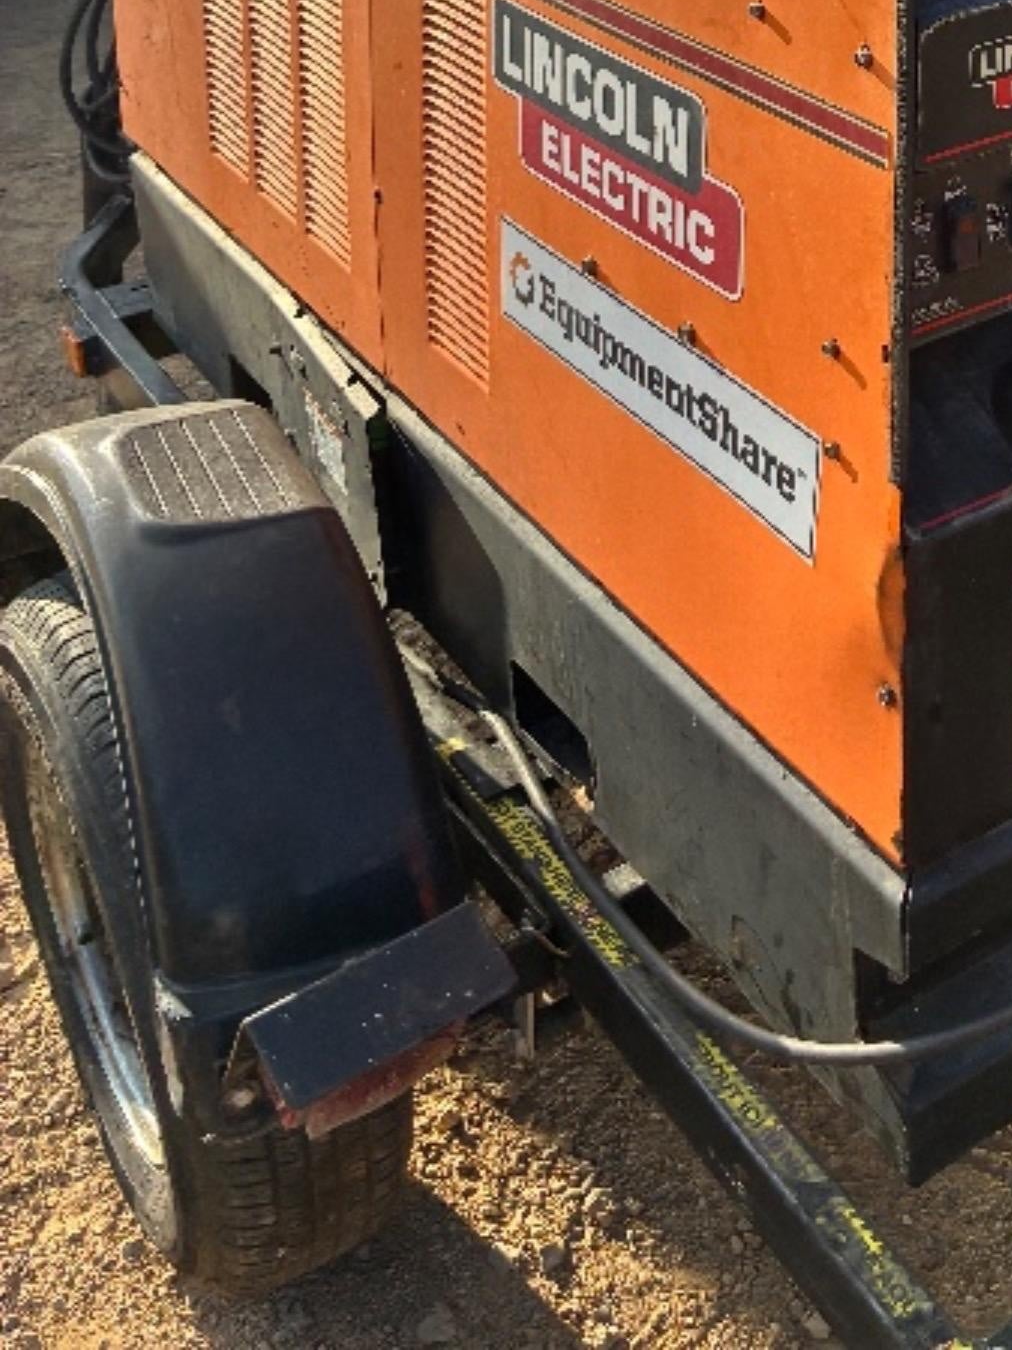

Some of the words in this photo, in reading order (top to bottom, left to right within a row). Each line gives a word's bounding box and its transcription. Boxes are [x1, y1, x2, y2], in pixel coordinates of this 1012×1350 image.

[502, 13, 690, 178] LINCOLN
[540, 118, 716, 266] ELECTRIC
[538, 274, 798, 504] EquipmentShare
